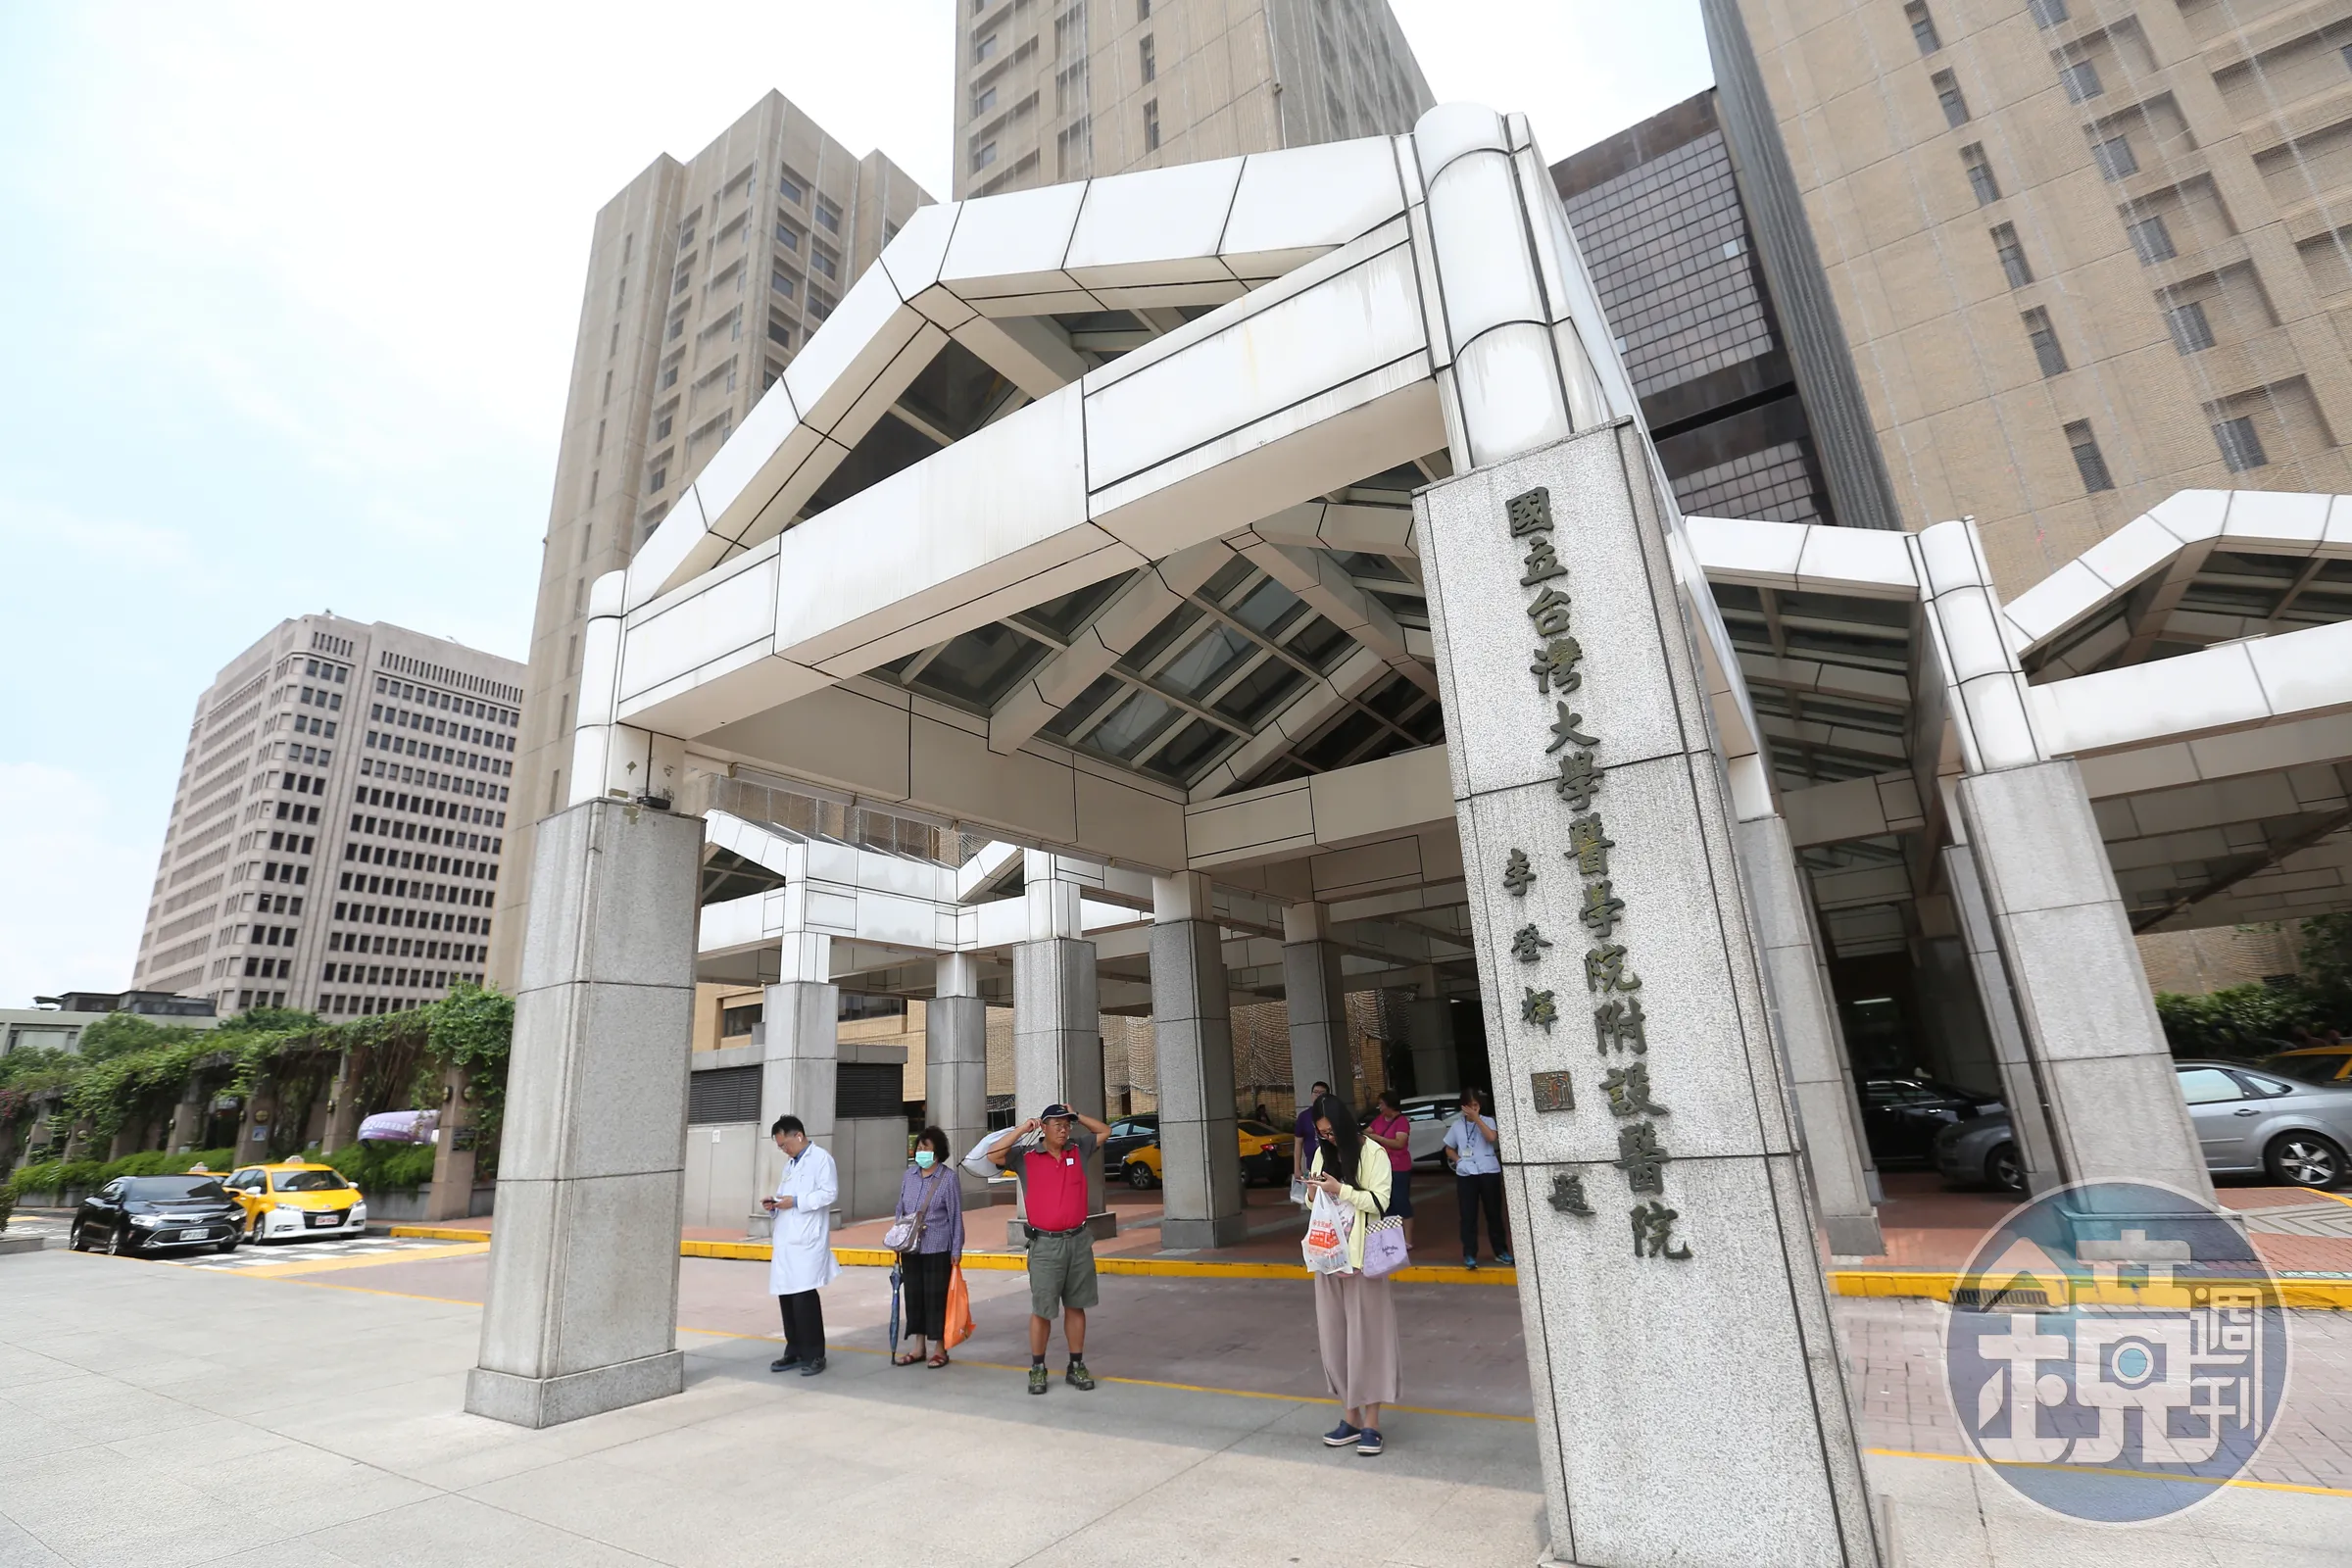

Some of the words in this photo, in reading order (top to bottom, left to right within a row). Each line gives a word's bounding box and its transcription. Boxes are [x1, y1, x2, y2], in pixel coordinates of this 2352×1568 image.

[1504, 486, 1693, 1260] 國立台灣大學醫學院附設醫院
